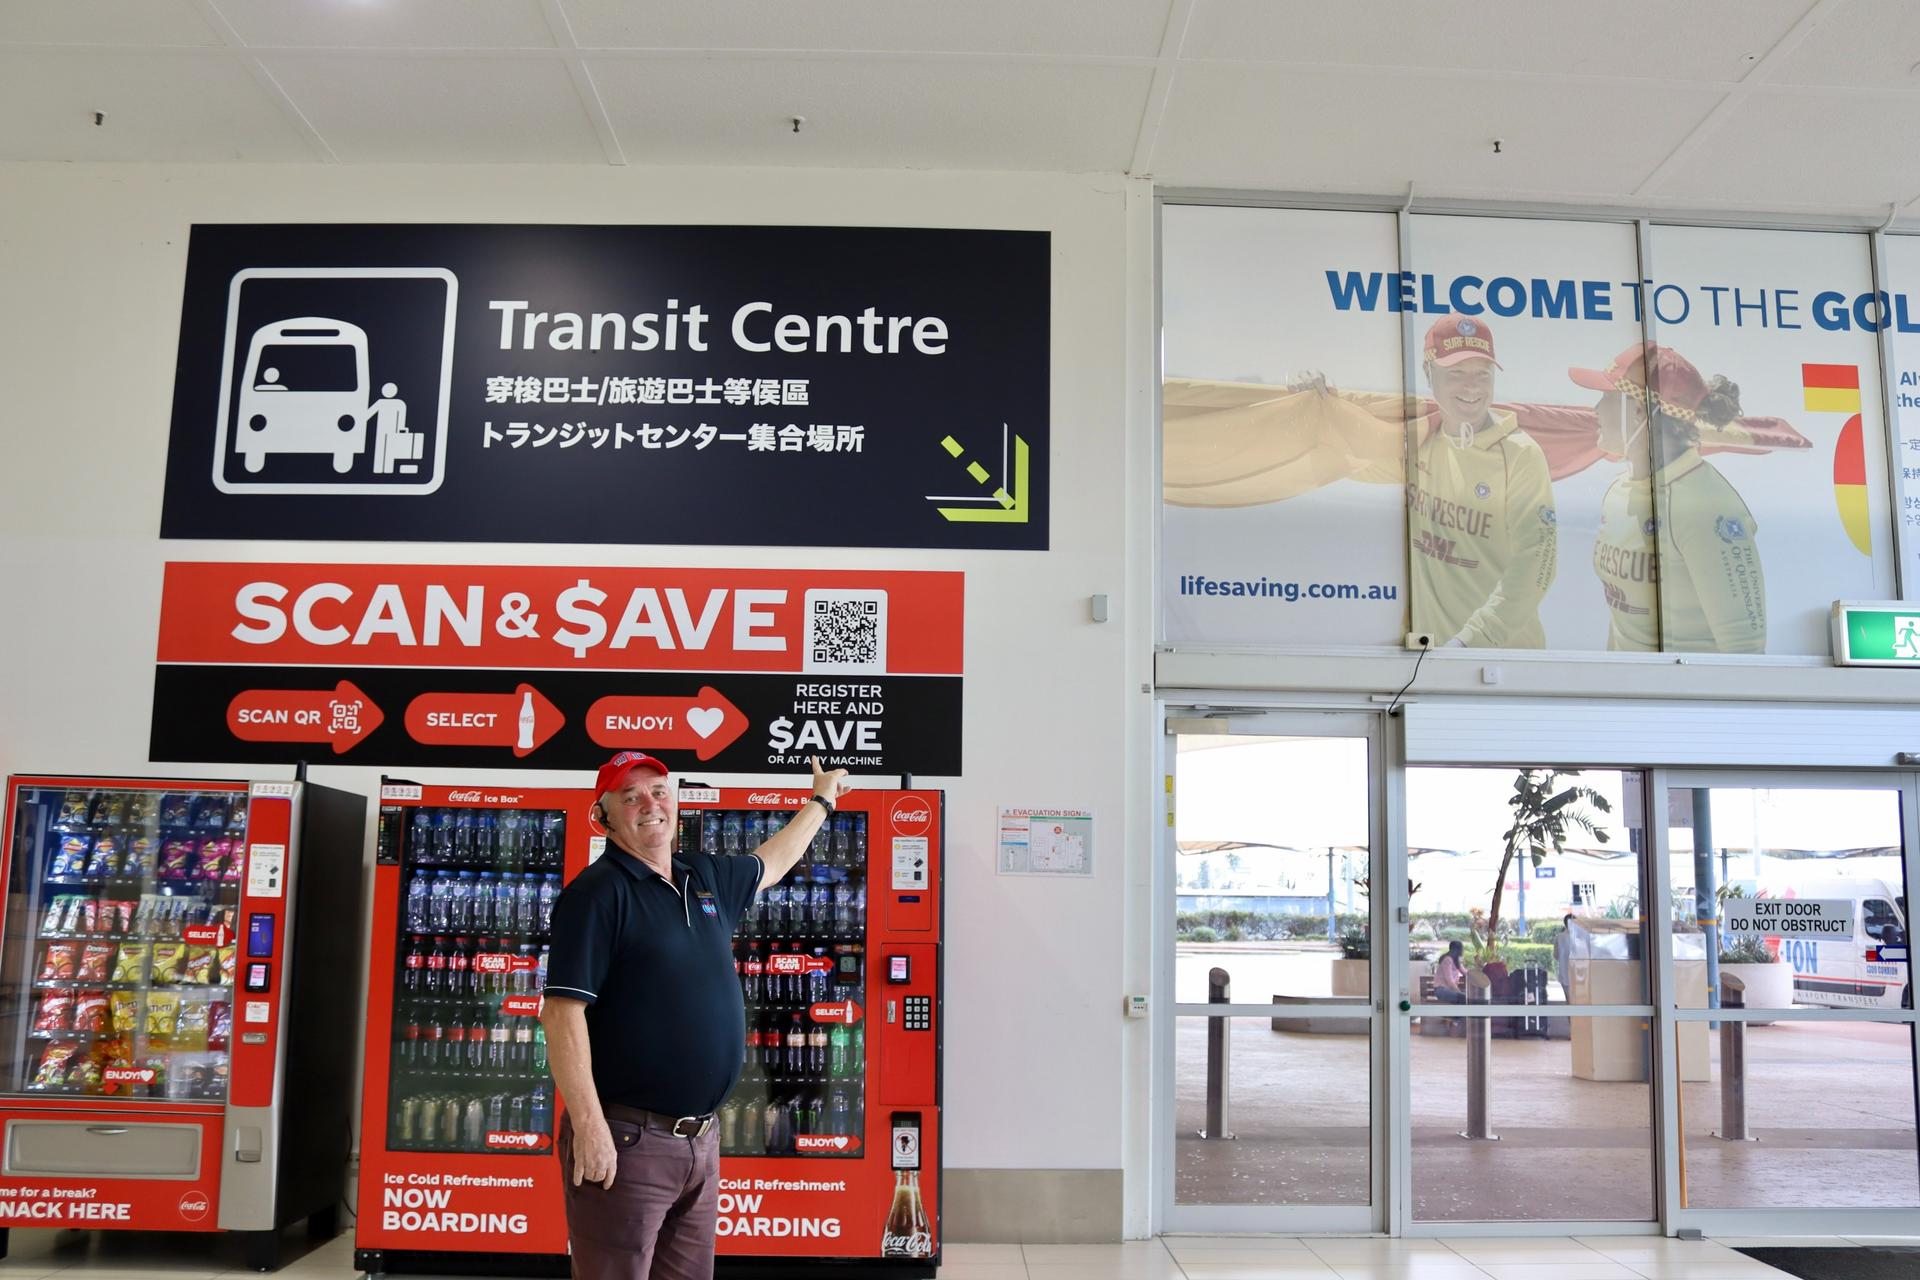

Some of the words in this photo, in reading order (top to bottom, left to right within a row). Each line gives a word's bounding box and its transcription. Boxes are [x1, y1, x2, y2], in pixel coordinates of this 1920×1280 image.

[1325, 270, 1613, 321] WELCOME
[1622, 280, 1690, 325] TO
[1701, 287, 1801, 329] THE
[489, 299, 709, 351] Transit
[731, 301, 949, 354] Centre
[1443, 337, 1465, 351] SURF
[482, 421, 865, 453] トランジットセンター集合場所
[1180, 576, 1397, 602] lifesaving.com.au
[230, 581, 485, 648] SCAN
[495, 592, 540, 639] &
[551, 578, 788, 659] $AVE
[796, 684, 882, 698] REGISTER
[793, 701, 841, 714] HERE
[845, 702, 884, 715] AND
[237, 709, 288, 724] SCAN
[293, 710, 321, 725] QR
[426, 712, 497, 728] SELECT
[605, 715, 673, 731] ENJOY!
[768, 716, 882, 754] $AVE
[767, 755, 785, 764] OR
[787, 755, 801, 764] AT
[830, 756, 883, 766] MACHINE
[484, 795, 498, 803] Ice
[784, 797, 798, 805] Ice
[1012, 808, 1061, 816] EVACUATION
[1755, 903, 1781, 916] EXIT
[1785, 903, 1821, 916] DOOR
[1731, 918, 1749, 931] DO
[1752, 919, 1777, 932] NOT
[1781, 919, 1846, 932] OBSTRUCT
[188, 931, 217, 939] SELECT
[508, 1002, 537, 1010] SELECT
[815, 1008, 845, 1016] SELECT
[384, 1173, 404, 1184] Ice
[408, 1173, 440, 1185] Cold
[443, 1175, 534, 1188] Refreshment
[719, 1179, 751, 1190] Cold
[754, 1179, 846, 1191] Refreshment
[20, 1187, 40, 1197] for
[42, 1189, 50, 1197] a
[53, 1187, 97, 1198] break?
[384, 1188, 452, 1208] NOW
[68, 1203, 131, 1220] HERE
[717, 1194, 763, 1214] OW
[383, 1211, 528, 1234] BOARDING
[715, 1216, 841, 1238] OARDING
